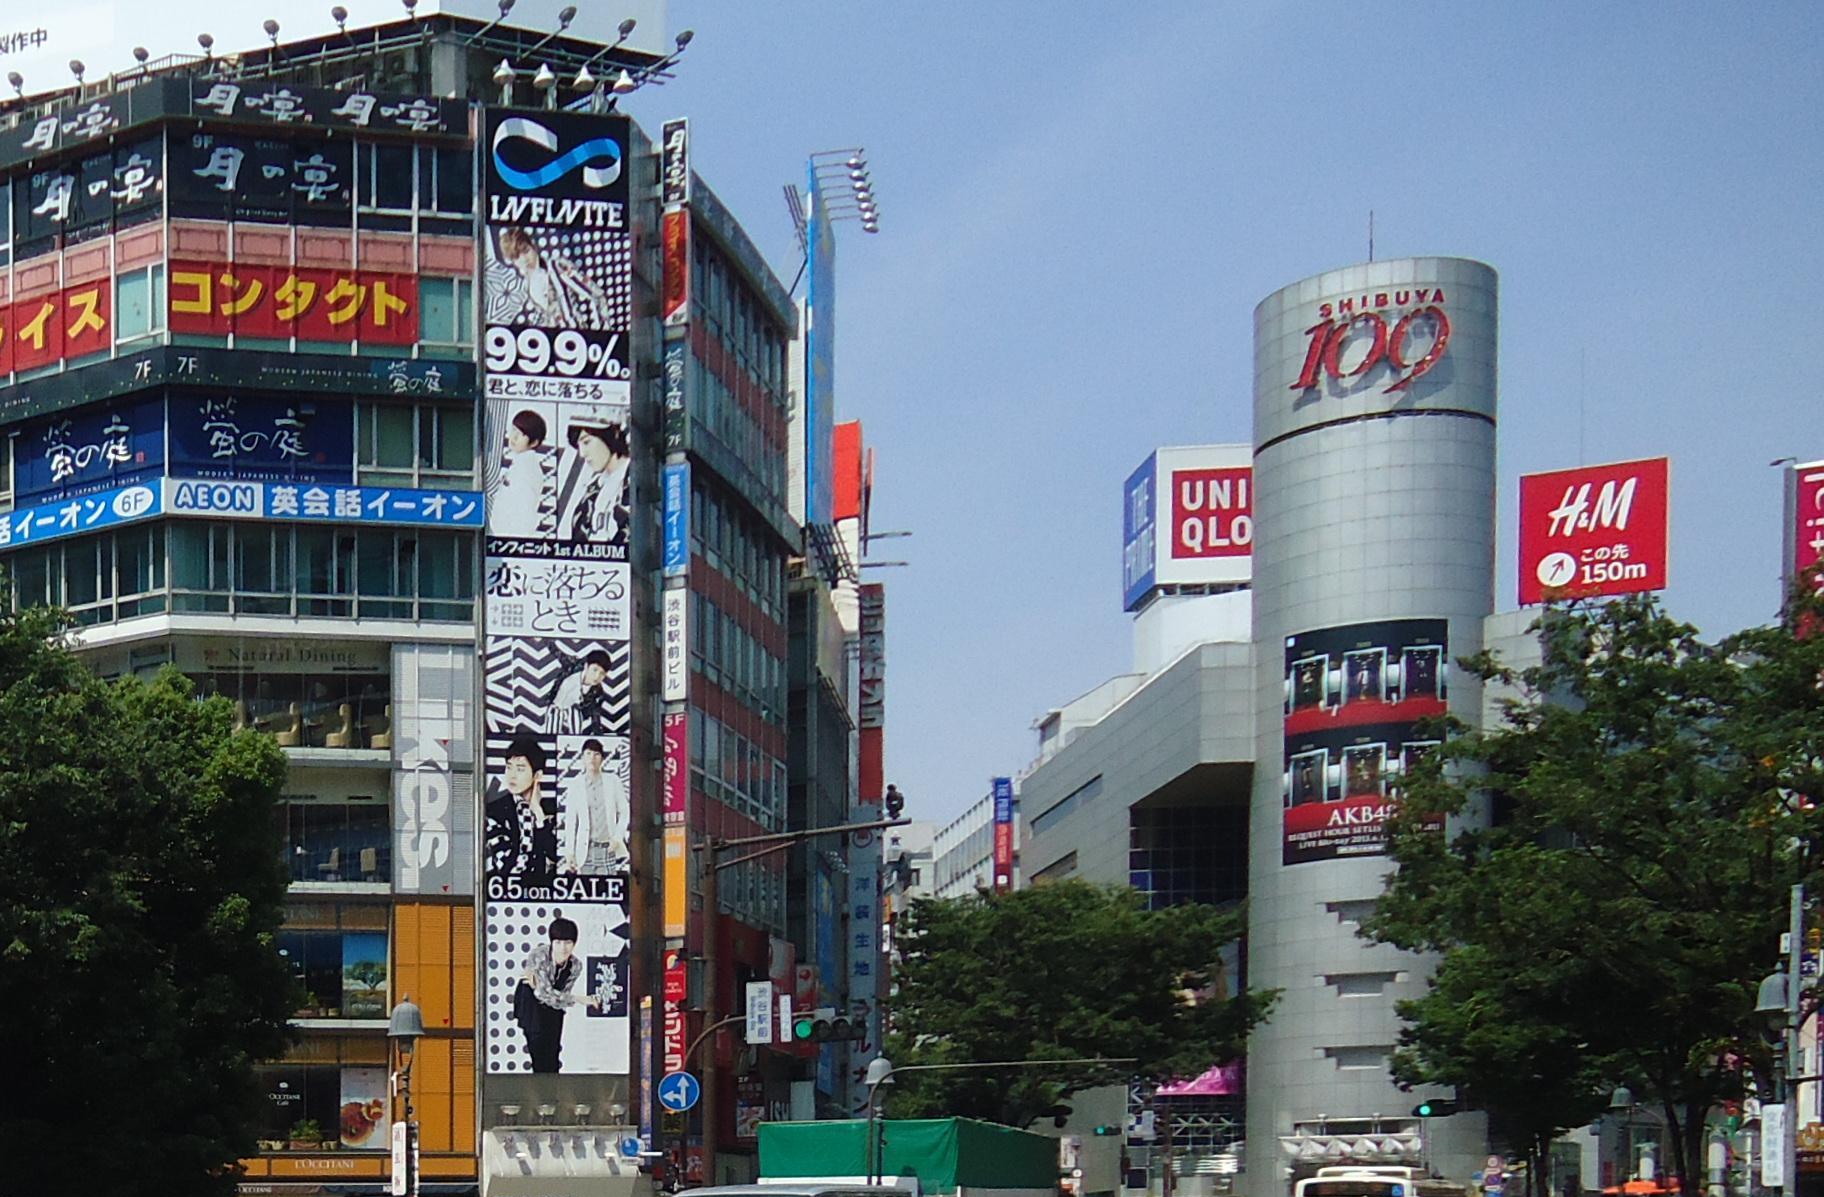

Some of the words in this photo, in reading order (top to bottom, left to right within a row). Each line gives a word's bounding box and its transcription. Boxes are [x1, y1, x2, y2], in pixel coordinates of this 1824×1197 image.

[490, 194, 624, 228] INFINITE
[171, 271, 407, 326] コンタクト
[1319, 287, 1445, 318] SHIBUYA
[177, 356, 198, 374] 7F
[1289, 304, 1451, 395] 109
[135, 360, 153, 380] 7F
[121, 492, 146, 512] 6F
[176, 482, 255, 512] AEON
[271, 485, 476, 521] 英会話イーオン
[1182, 478, 1247, 511] UNI
[1547, 476, 1637, 537] H&M
[1182, 514, 1253, 553] QLO
[488, 540, 552, 555] インフィニット
[554, 543, 570, 556] 1st
[573, 544, 626, 559] ALBUM
[1580, 543, 1629, 562] この先
[487, 561, 625, 600] 恋に落ちる
[1580, 561, 1647, 584] 150m
[531, 600, 581, 633] とき
[228, 648, 289, 663] Natural
[299, 648, 358, 665] Dining
[667, 598, 681, 691] 渋谷駅前ビル
[664, 715, 684, 727] 5F
[487, 875, 522, 900] 6.5
[528, 886, 551, 900] on
[553, 877, 624, 900] SALE
